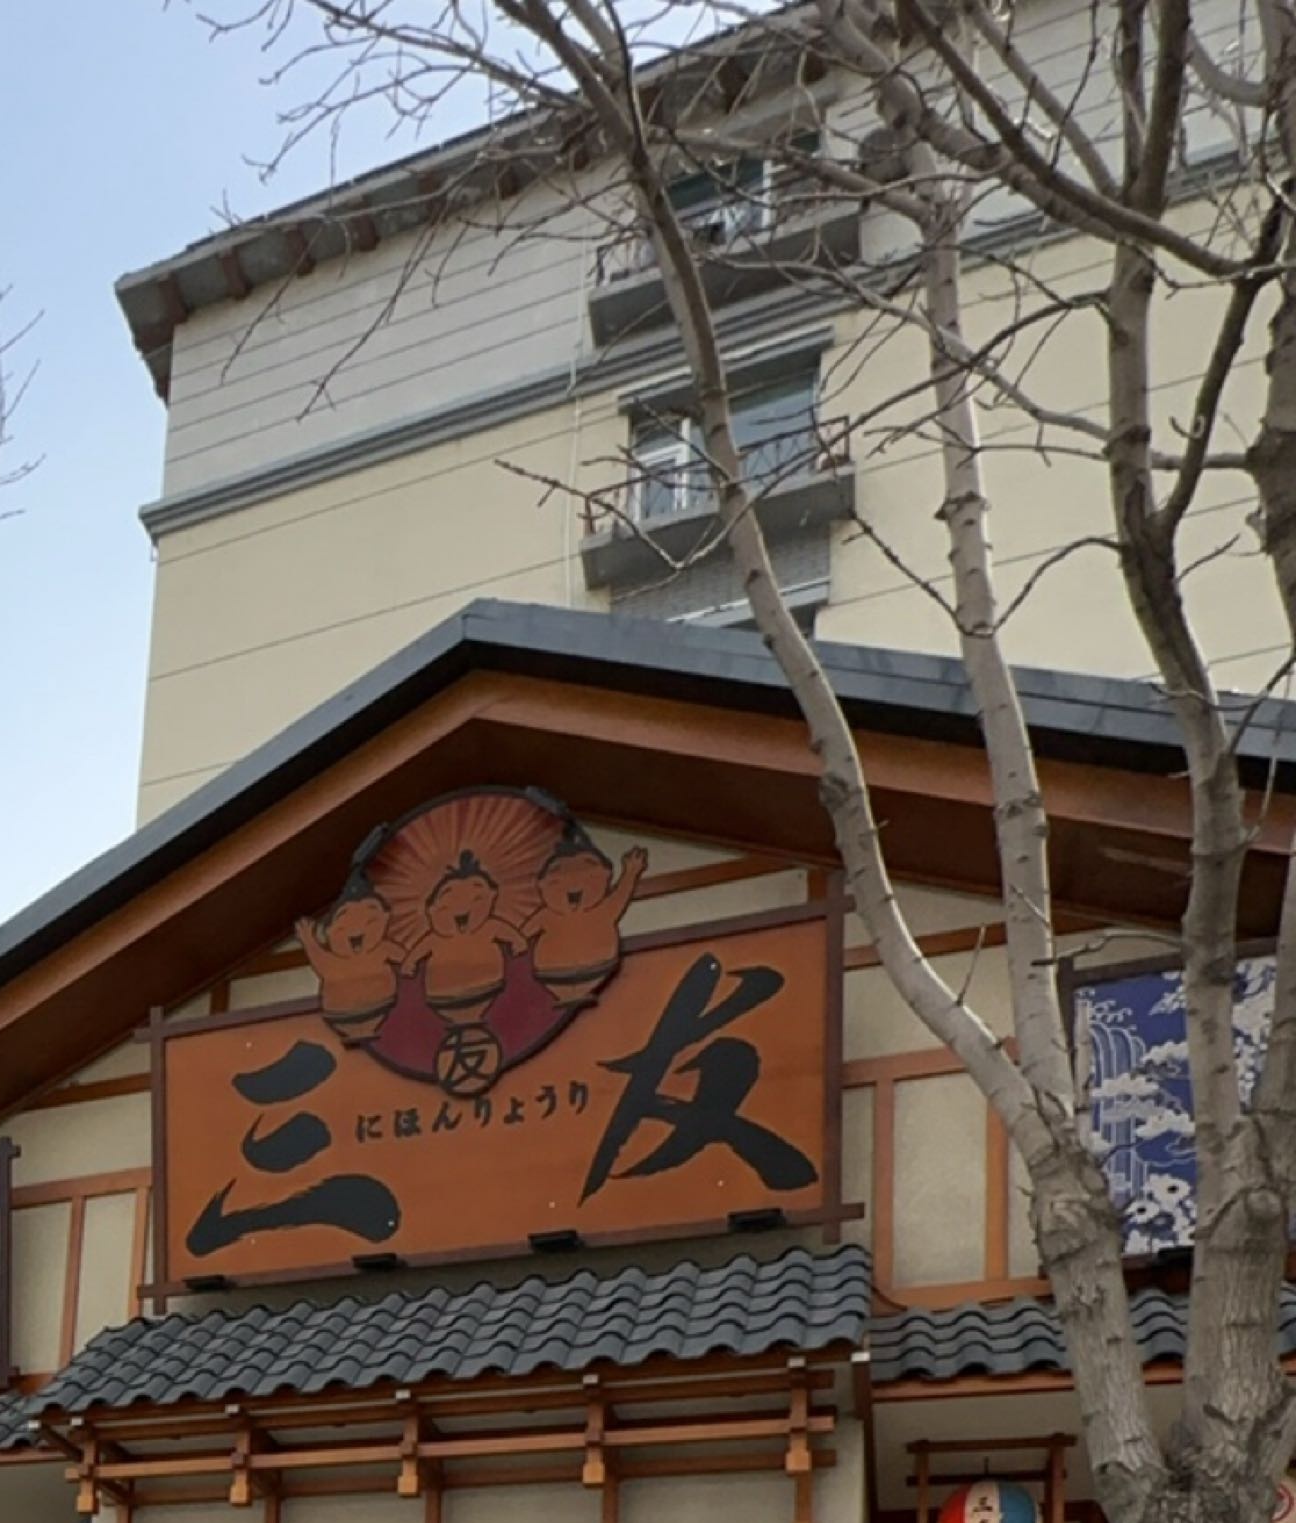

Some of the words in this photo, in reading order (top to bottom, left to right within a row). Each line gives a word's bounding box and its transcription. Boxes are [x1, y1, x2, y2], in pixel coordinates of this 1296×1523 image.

[357, 1081, 589, 1142] にほんりょうり
